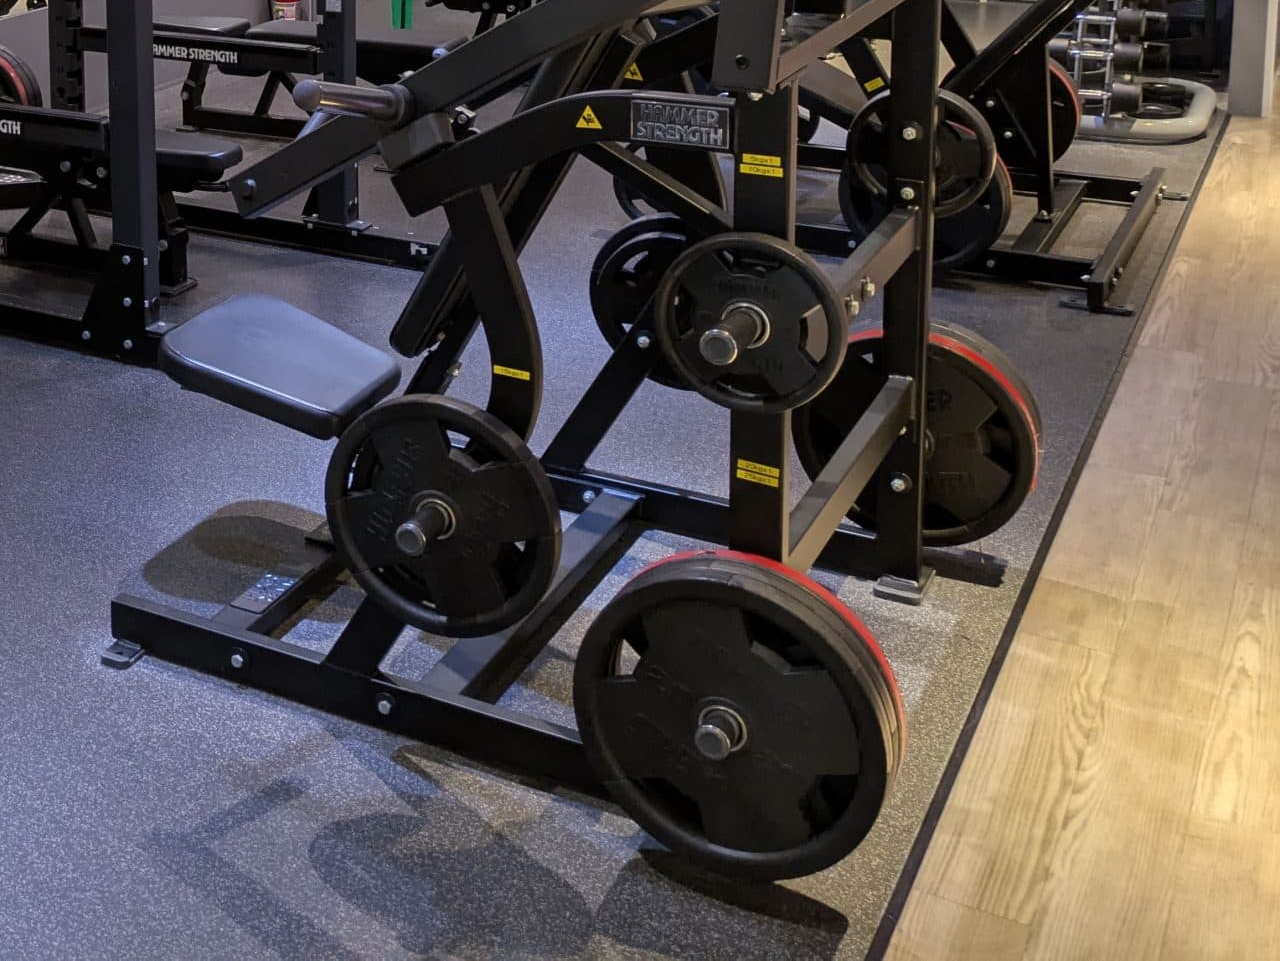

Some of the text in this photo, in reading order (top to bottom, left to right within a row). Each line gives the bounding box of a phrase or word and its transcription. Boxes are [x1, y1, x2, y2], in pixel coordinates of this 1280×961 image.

[153, 43, 238, 64] AMMER STRENGTH
[639, 103, 719, 127] HAMMER
[636, 122, 723, 146] STRENGTH
